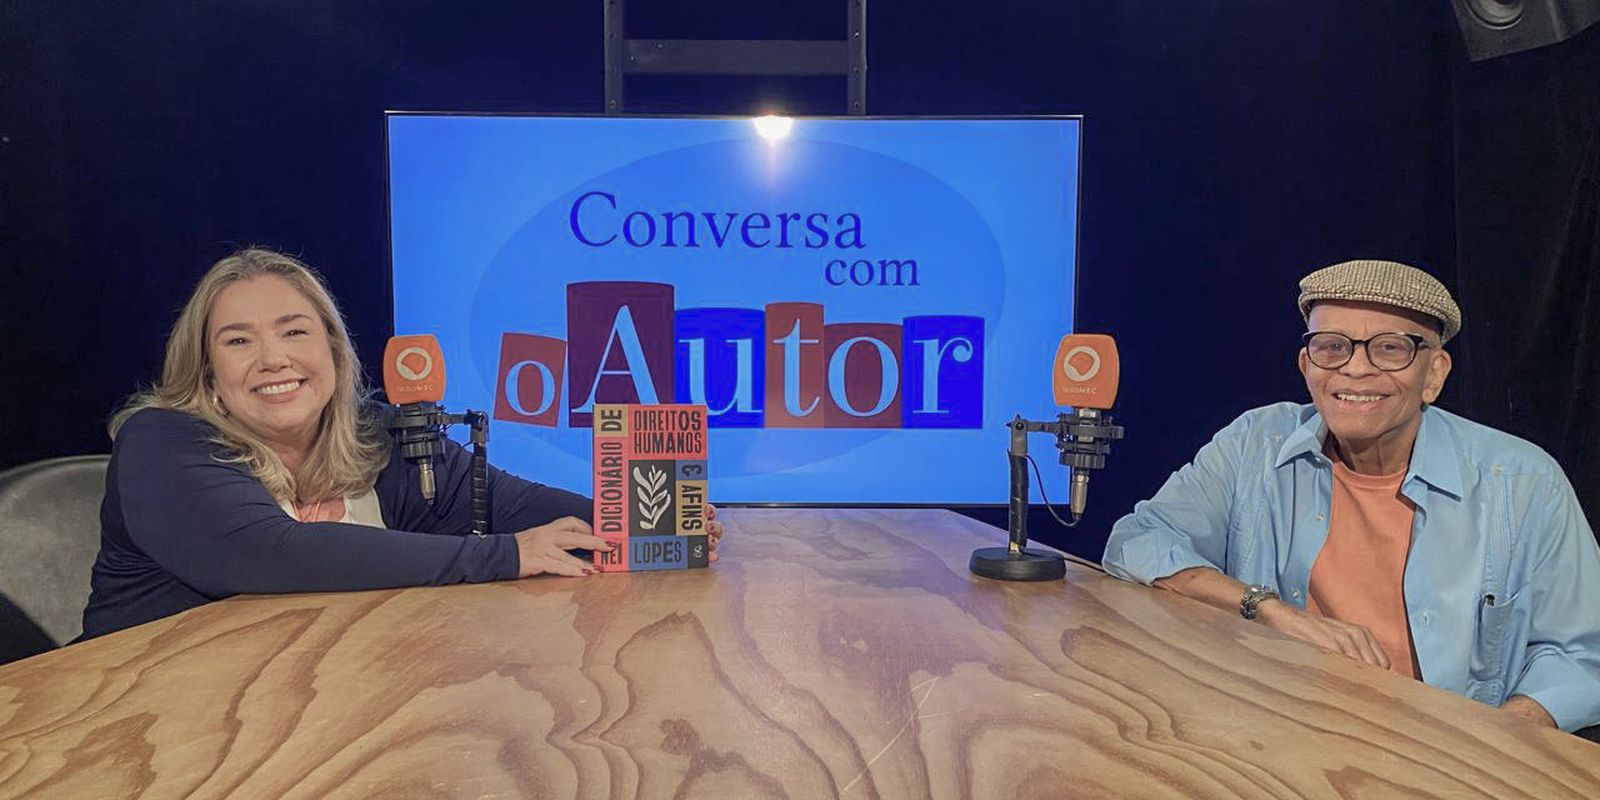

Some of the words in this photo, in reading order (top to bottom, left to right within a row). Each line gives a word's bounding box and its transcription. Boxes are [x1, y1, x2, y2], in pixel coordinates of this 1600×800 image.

[569, 191, 866, 249] Conversa
[824, 257, 920, 286] com
[505, 360, 556, 416] o
[571, 305, 974, 417] Autor
[601, 410, 622, 432] DE
[634, 410, 702, 431] DIREITOS
[634, 432, 702, 454] HUMANOS
[598, 442, 623, 532] DICIONÁRIO
[682, 484, 702, 531] AFINS
[634, 541, 682, 564] LOPES
